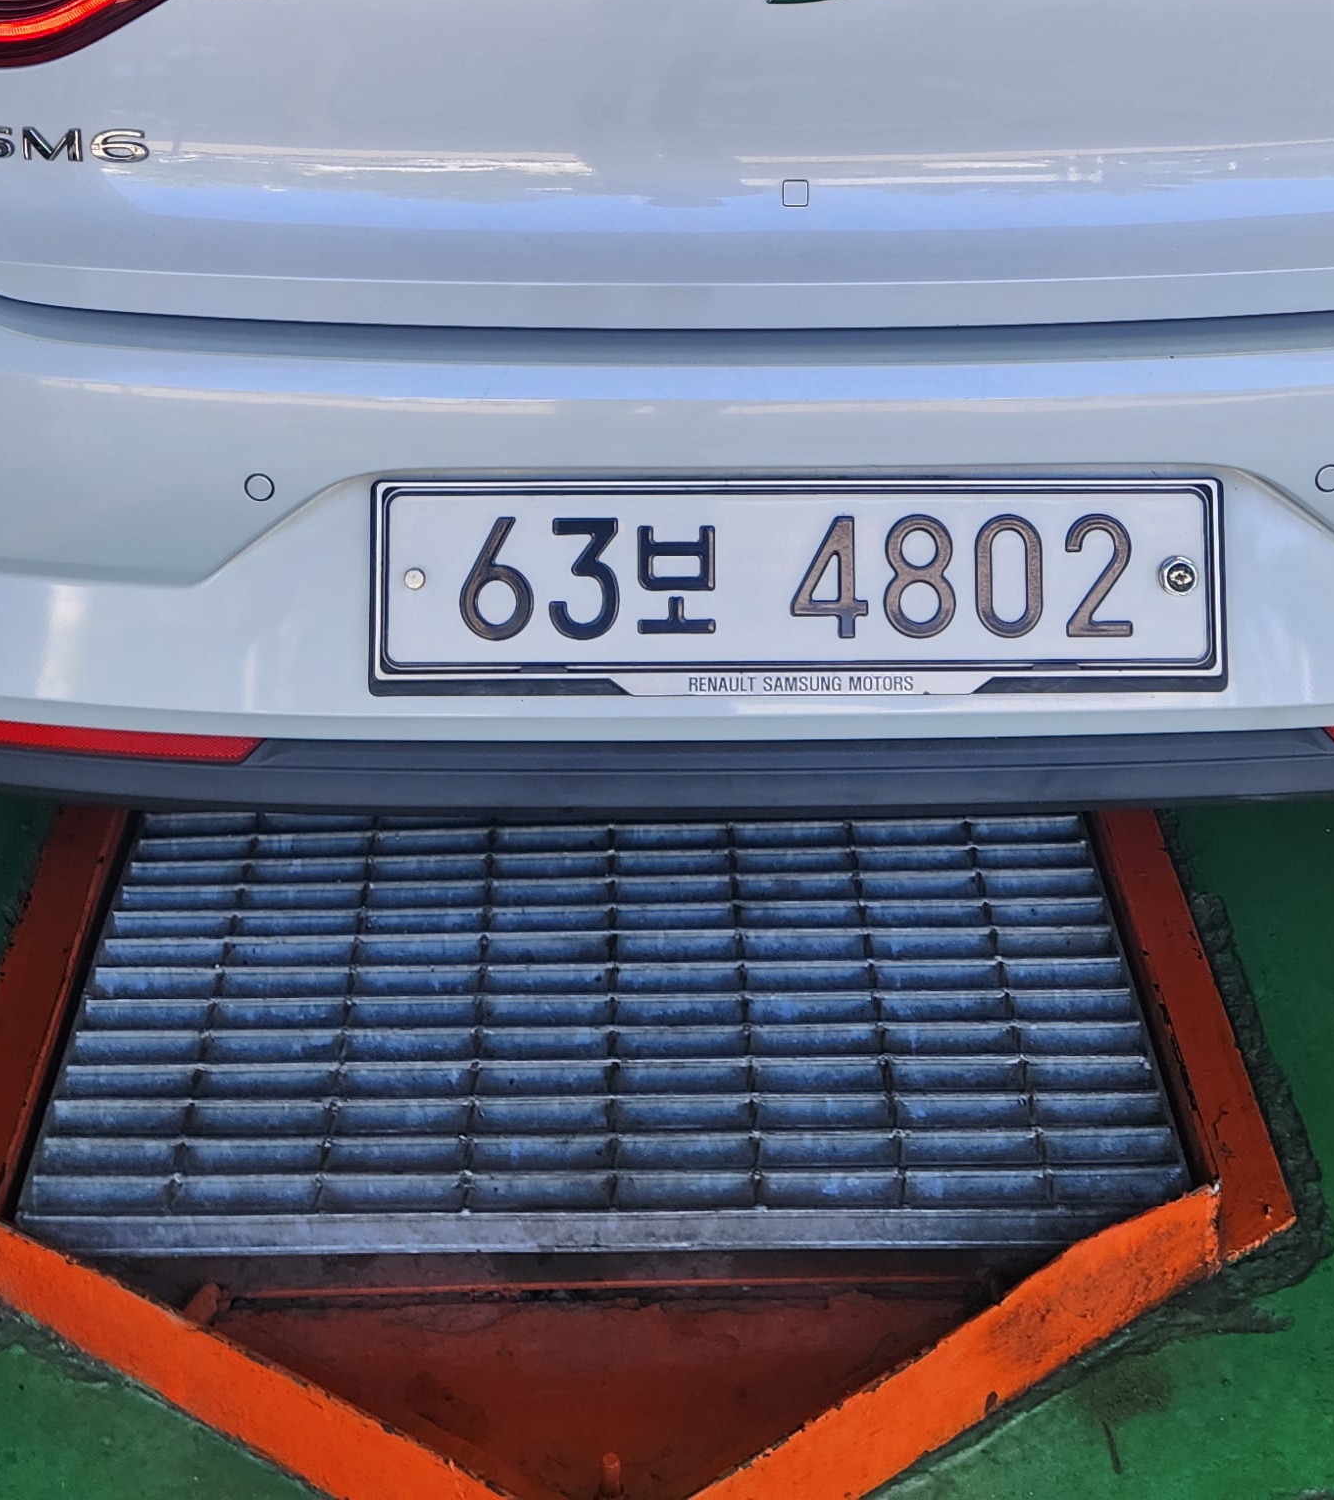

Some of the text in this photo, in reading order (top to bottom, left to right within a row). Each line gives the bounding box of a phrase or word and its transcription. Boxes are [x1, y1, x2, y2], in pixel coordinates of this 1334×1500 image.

[459, 513, 1134, 642] 63보 4802
[688, 675, 914, 692] RENAULT SAMSUNG MOTORS
